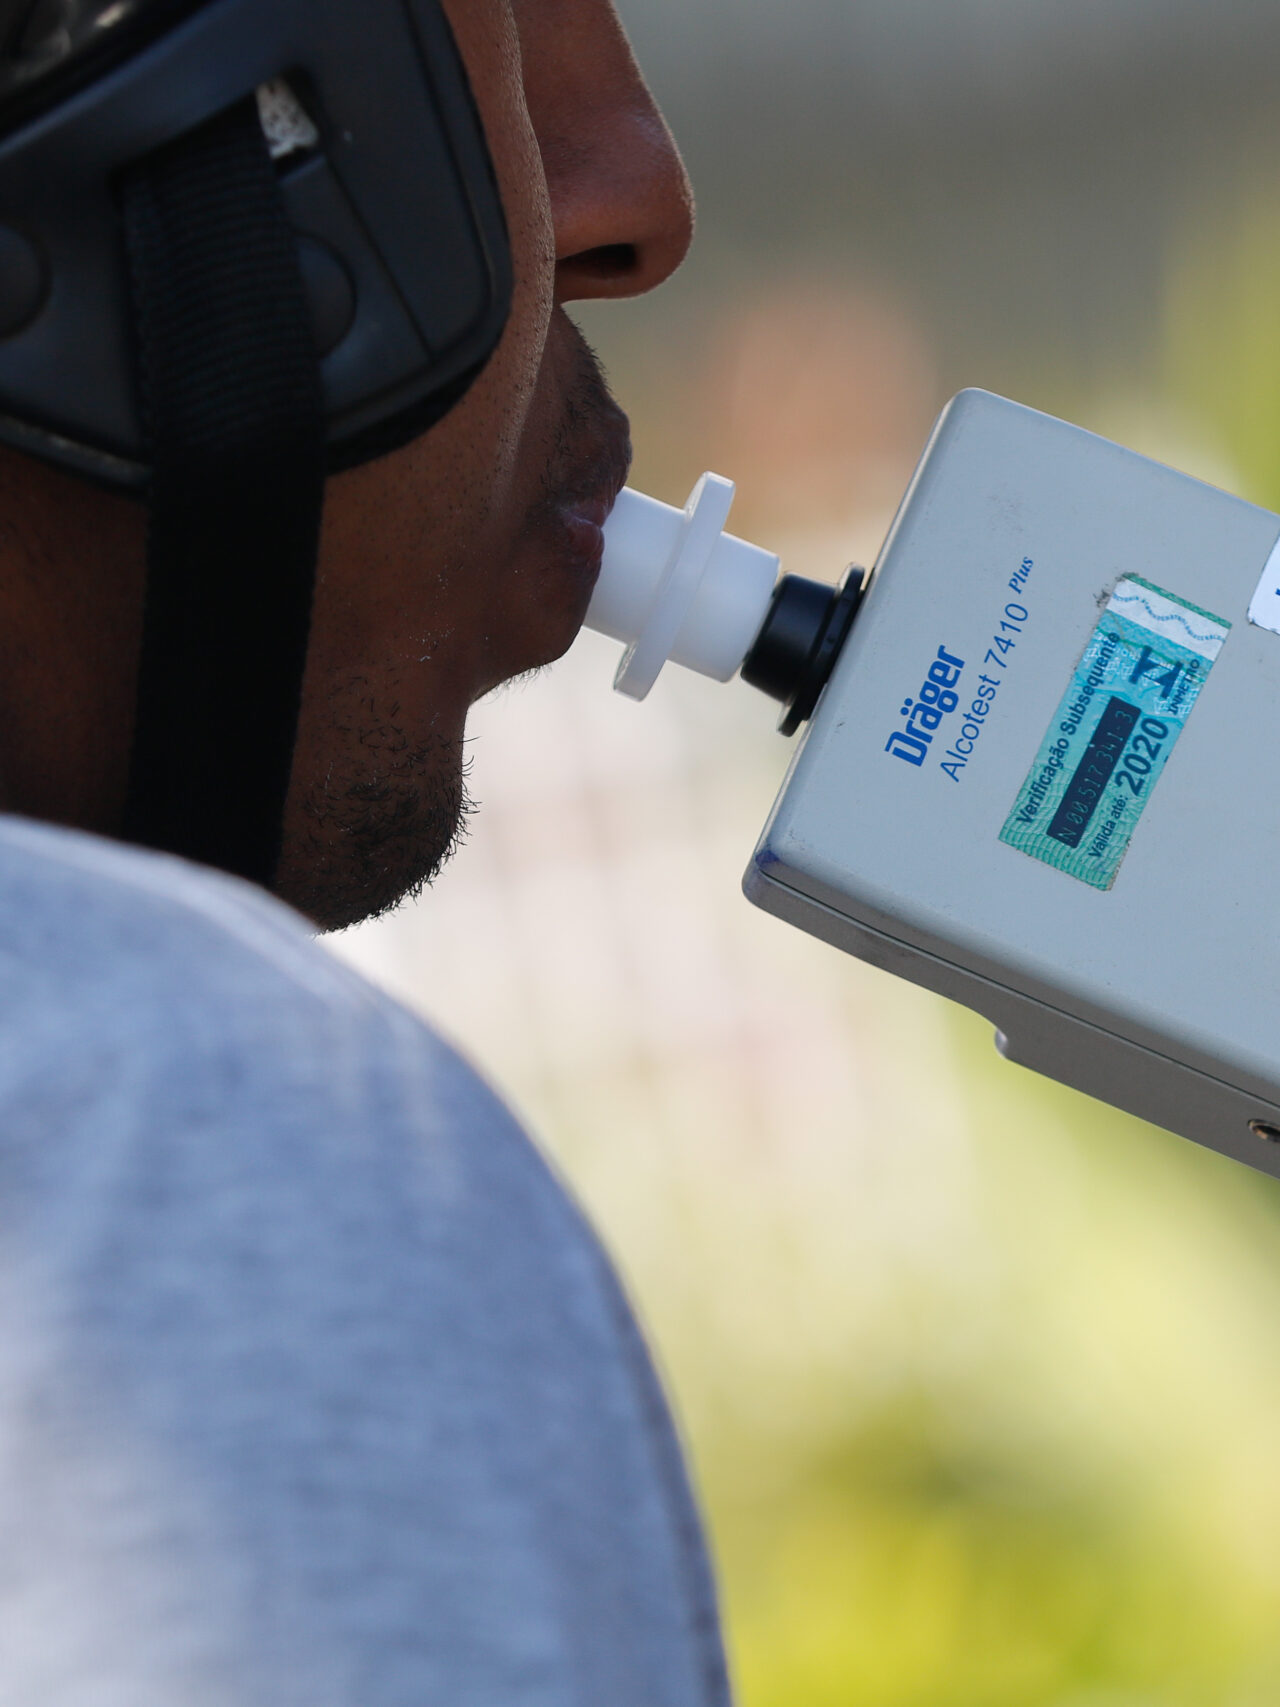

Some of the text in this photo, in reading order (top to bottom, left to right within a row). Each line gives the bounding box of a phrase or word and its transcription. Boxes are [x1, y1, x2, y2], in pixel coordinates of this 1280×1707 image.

[884, 645, 966, 767] Dräger
[940, 556, 1034, 783] Alcotest 7410 Plus
[1016, 631, 1122, 826] Verificação Subsequente
[1089, 718, 1170, 859] Válida até: 2020
